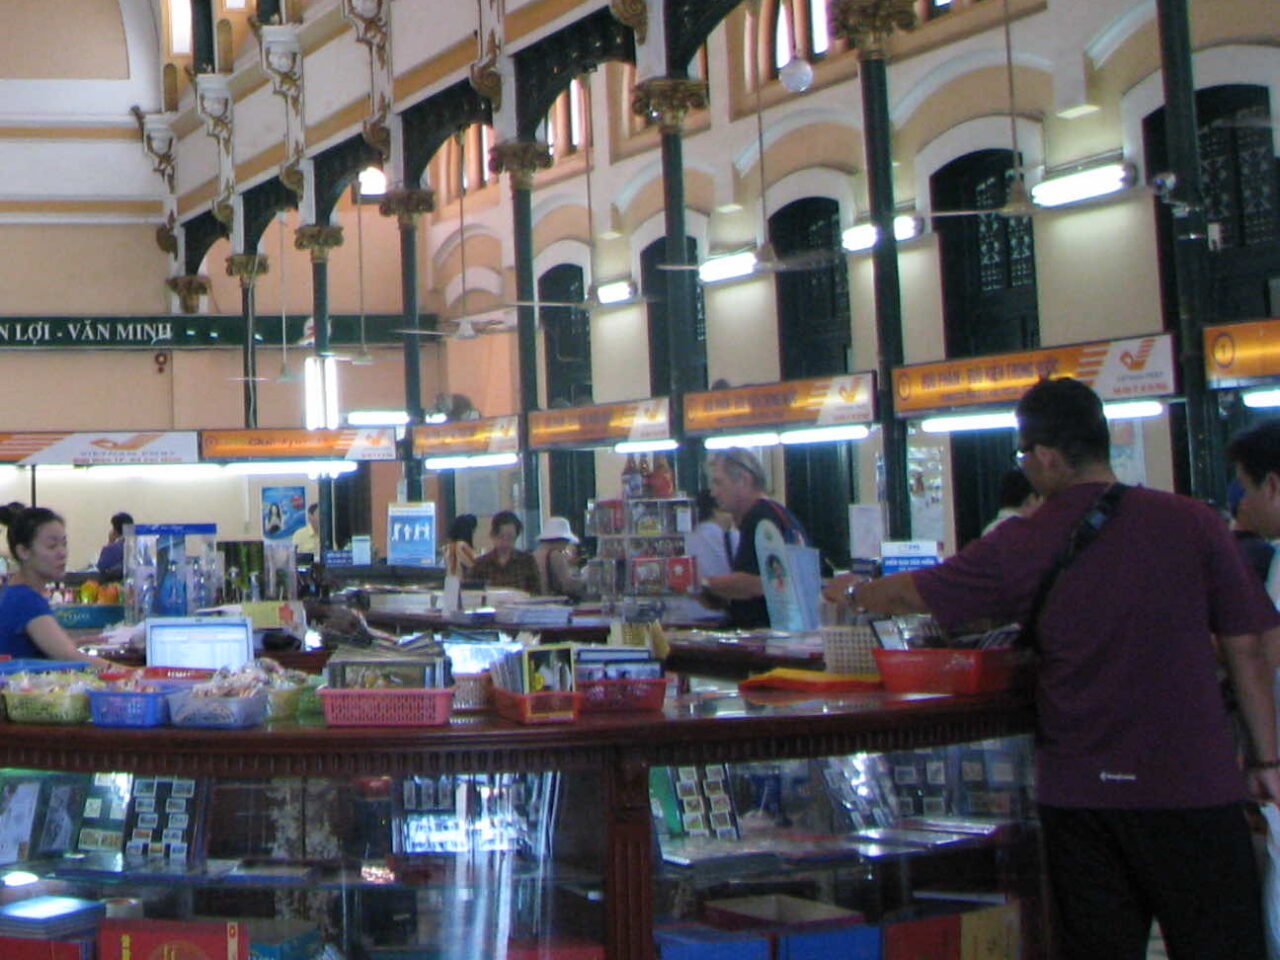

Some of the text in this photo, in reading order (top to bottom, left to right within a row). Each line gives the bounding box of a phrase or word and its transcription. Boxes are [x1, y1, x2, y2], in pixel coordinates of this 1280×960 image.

[15, 321, 50, 345] LỢI
[67, 319, 110, 341] VĂN
[116, 322, 172, 342] MINH
